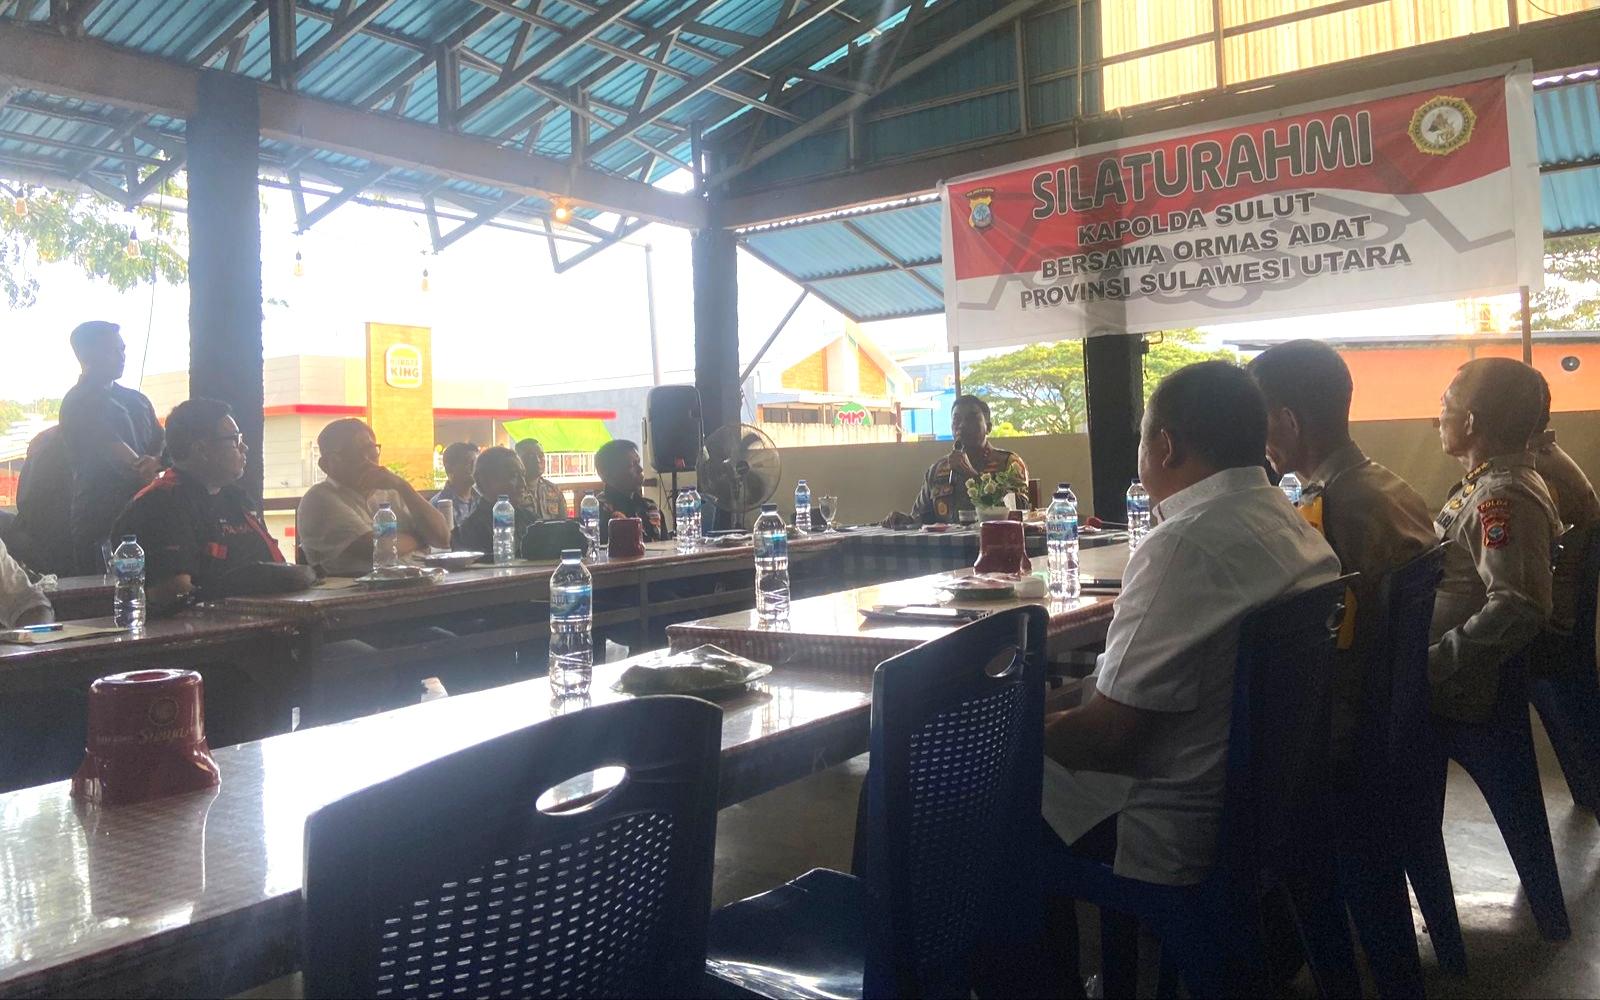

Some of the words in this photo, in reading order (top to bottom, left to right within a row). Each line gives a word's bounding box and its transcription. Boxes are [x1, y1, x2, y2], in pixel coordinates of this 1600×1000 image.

[1032, 110, 1373, 219] SILATURAHMI
[1042, 245, 1166, 279] BERSAMA
[1173, 229, 1279, 262] ORMAS
[1288, 215, 1371, 247] ADAT
[1078, 209, 1207, 246] KAPOLDA
[1215, 192, 1315, 225] SULUT
[1020, 276, 1131, 308] PROVINSI
[1140, 258, 1291, 295] SULAWESI
[1301, 242, 1412, 276] UTARA
[391, 367, 419, 378] KING
